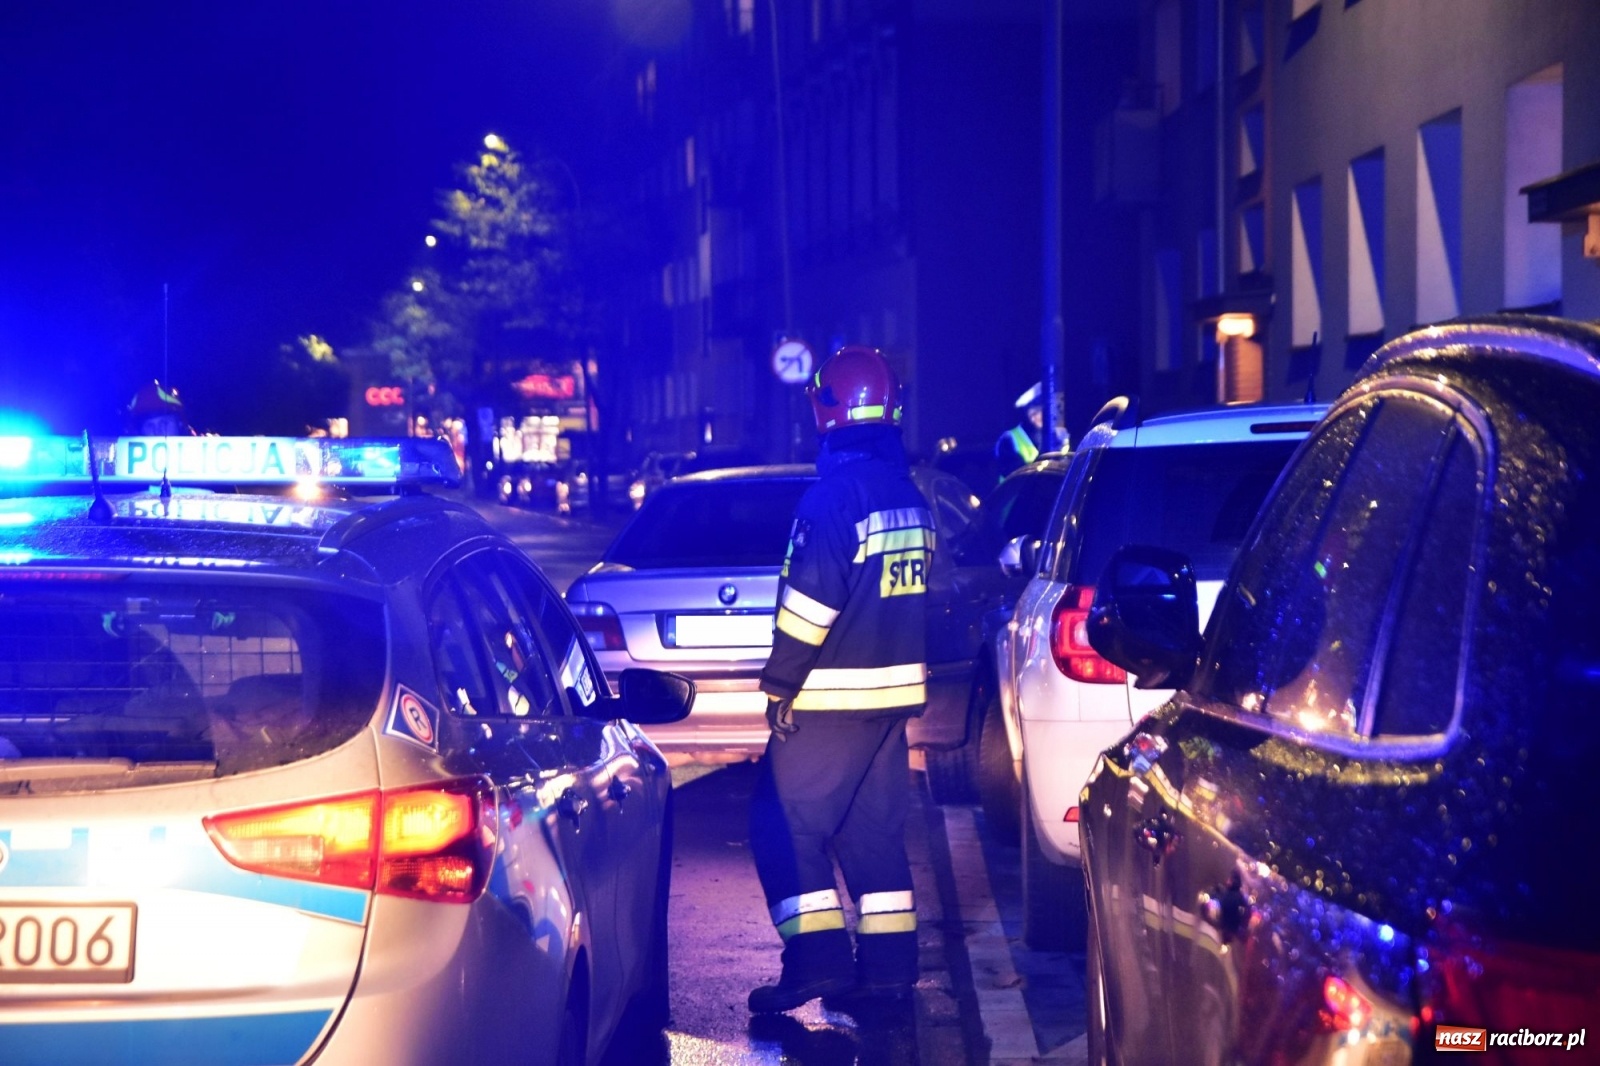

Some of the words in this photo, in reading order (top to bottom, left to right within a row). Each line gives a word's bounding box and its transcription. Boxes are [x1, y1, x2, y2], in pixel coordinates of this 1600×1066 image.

[127, 441, 286, 475] POLICJA
[409, 707, 427, 731] R
[0, 915, 114, 967] 006
